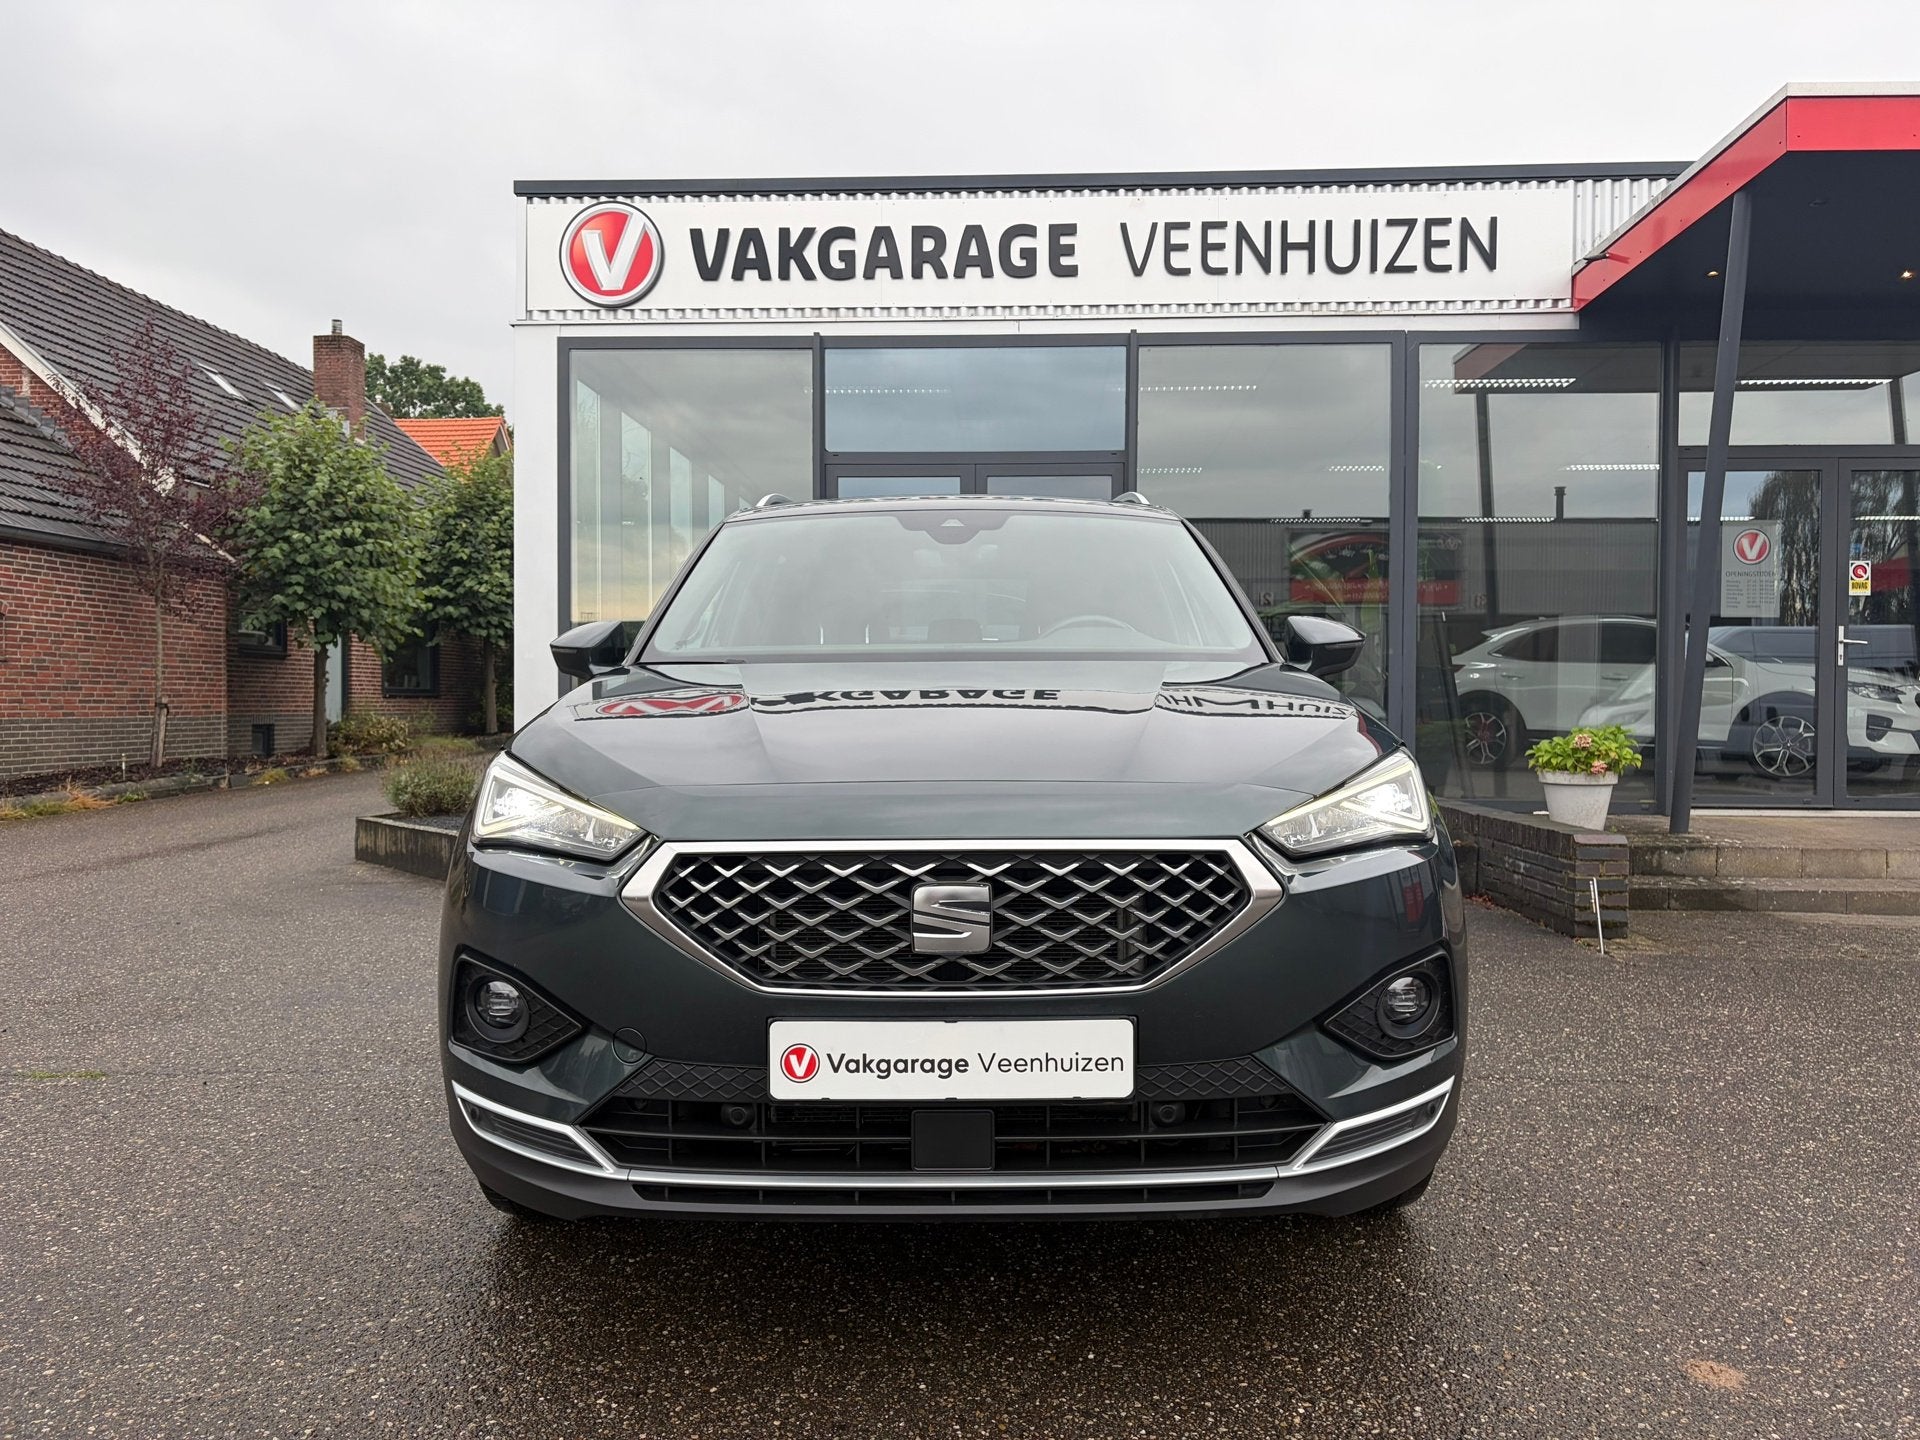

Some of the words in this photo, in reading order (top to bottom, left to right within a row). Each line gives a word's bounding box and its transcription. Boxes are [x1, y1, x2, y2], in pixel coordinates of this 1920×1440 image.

[690, 223, 1078, 281] VAKGARAGE
[1120, 216, 1498, 277] VEENHUIZEN
[827, 1053, 969, 1079] Vakgarage
[978, 1052, 1124, 1073] Veenhuizen
